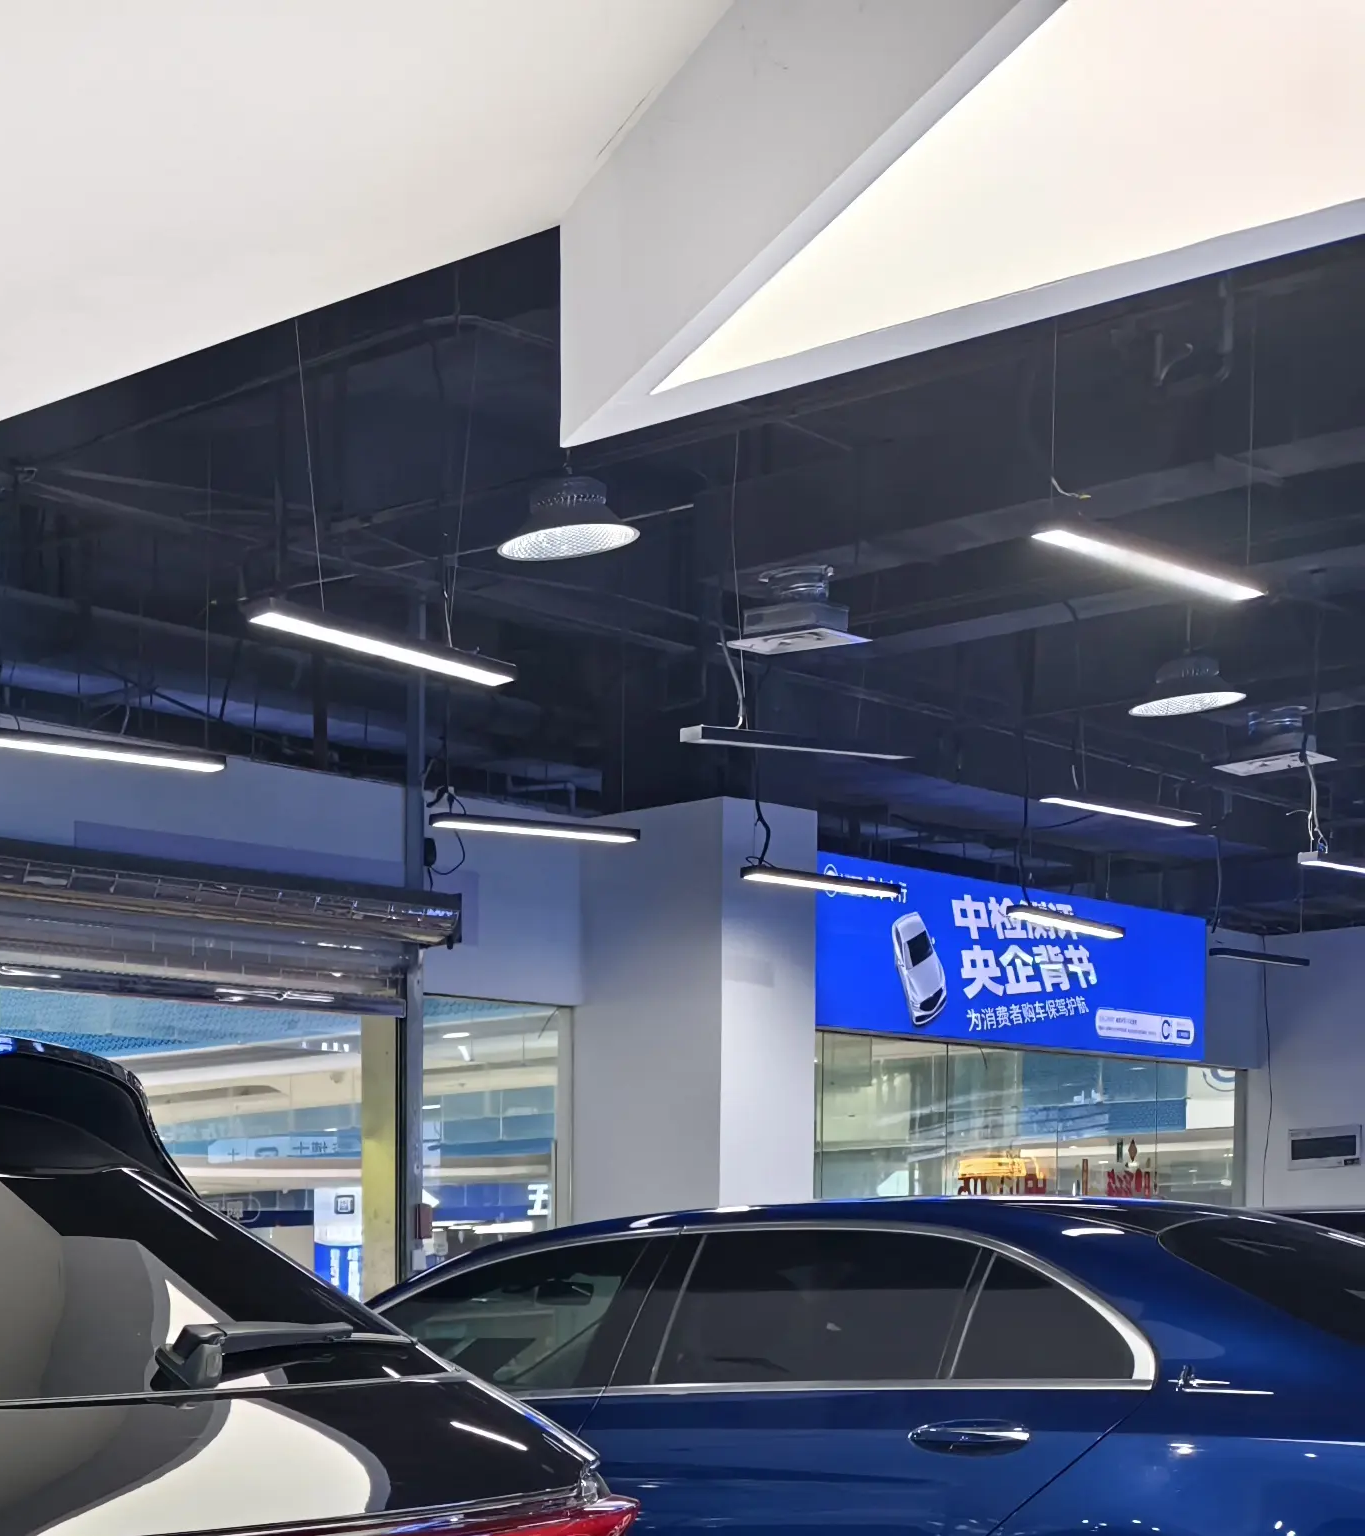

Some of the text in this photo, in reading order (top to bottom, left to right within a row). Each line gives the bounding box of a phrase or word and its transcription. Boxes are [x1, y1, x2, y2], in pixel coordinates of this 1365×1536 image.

[960, 944, 1097, 999] 央企背书
[966, 996, 1089, 1032] 为消费者购车保驾护航
